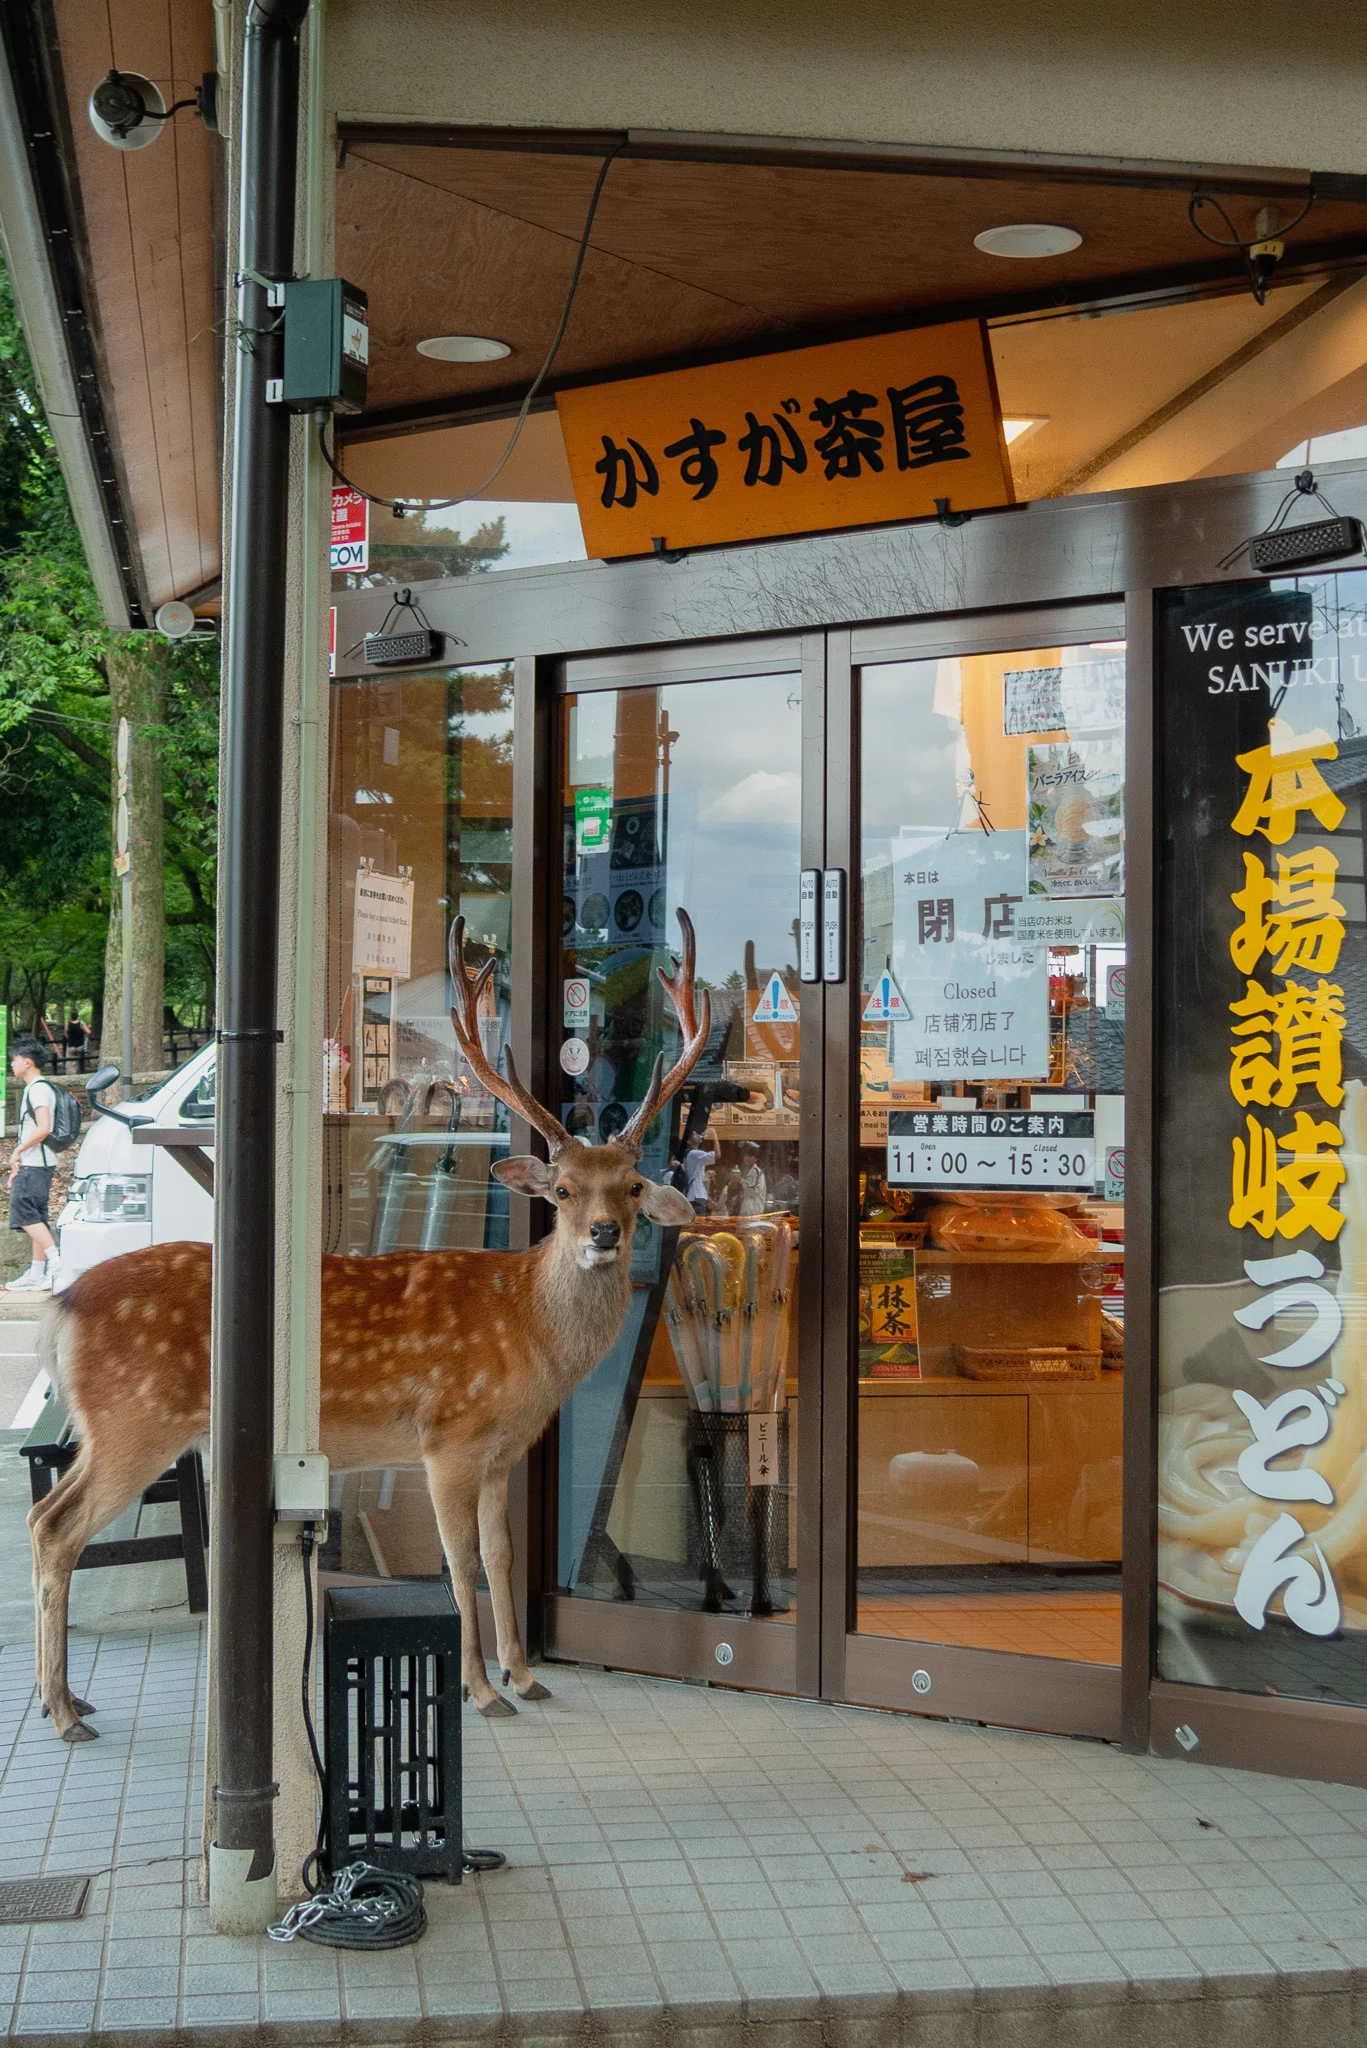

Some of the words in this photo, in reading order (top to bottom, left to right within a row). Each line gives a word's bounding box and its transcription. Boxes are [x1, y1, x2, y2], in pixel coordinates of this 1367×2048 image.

[595, 374, 972, 509] かすが茶屋
[1180, 622, 1234, 653] We
[1244, 620, 1325, 648] serve
[1208, 656, 1340, 695] SANUKI
[904, 870, 939, 885] 本日は
[1042, 868, 1067, 877] Vanilla
[802, 880, 814, 888] AUTO
[825, 880, 838, 888] AUTO
[801, 890, 814, 900] 自動
[825, 890, 838, 899] 自動
[801, 921, 814, 930] PUSH
[825, 921, 838, 930] PUSH
[918, 893, 1023, 945] 閉店
[1018, 915, 1073, 927] 当店のお米は
[1017, 927, 1121, 940] 国産米を使用しています。
[986, 951, 1034, 966] しました
[943, 981, 997, 1000] Closed
[762, 999, 789, 1010] 注意
[872, 997, 900, 1008] 注意
[924, 1011, 1015, 1034] 店铺闭店了
[915, 1044, 1027, 1068] 폐점했습니다
[912, 1115, 1066, 1135] 営業時間のご案内
[920, 1143, 937, 1151] Open
[1033, 1144, 1058, 1152] Closed
[893, 1151, 968, 1175] 11:00
[1008, 1153, 1086, 1177] 15:30
[876, 1284, 911, 1336] 抹茶
